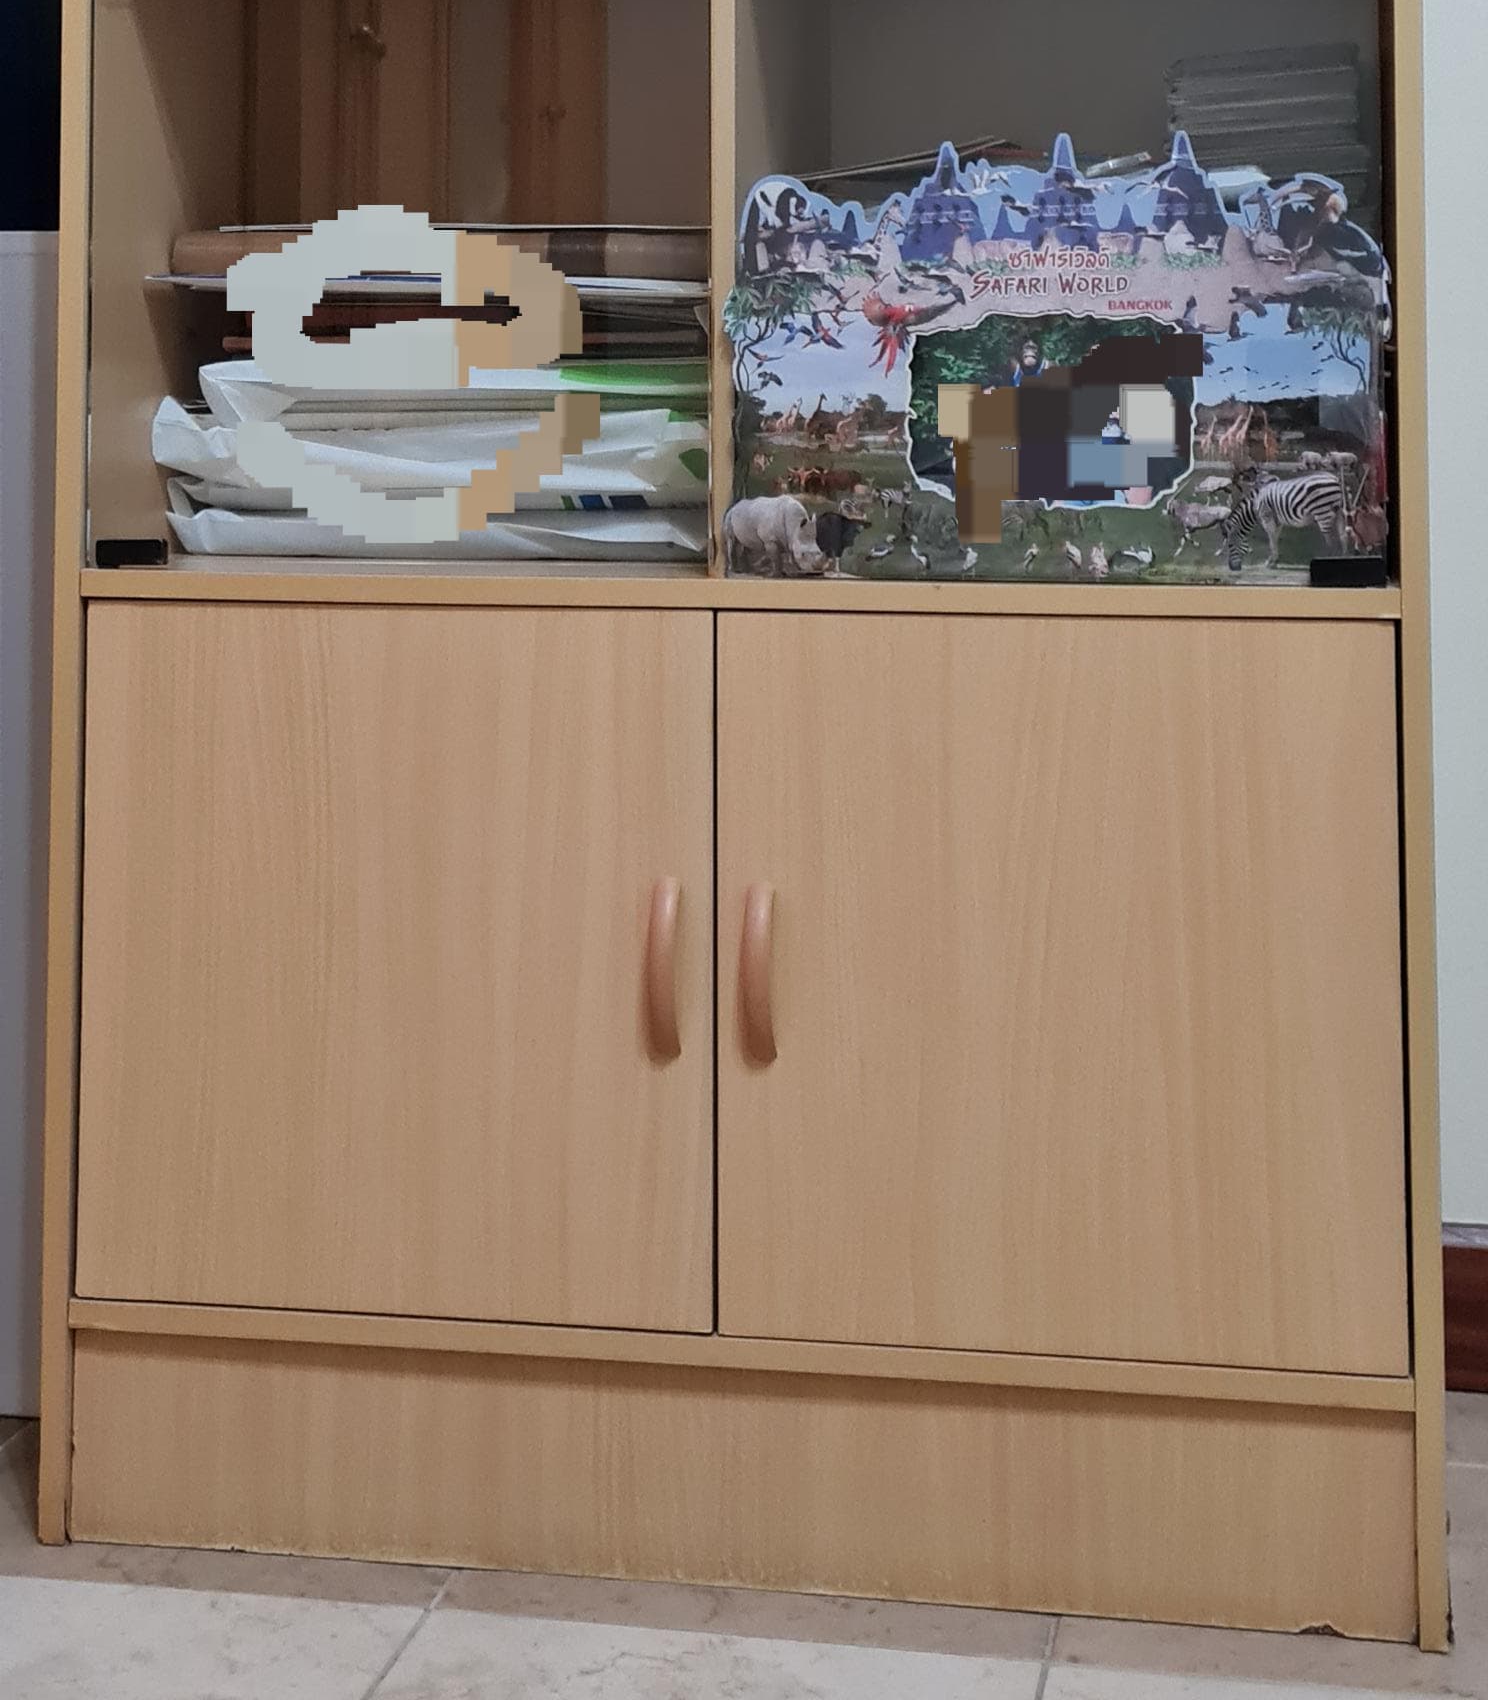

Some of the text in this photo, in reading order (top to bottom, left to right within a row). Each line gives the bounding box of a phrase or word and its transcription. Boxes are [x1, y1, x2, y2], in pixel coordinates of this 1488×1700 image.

[969, 270, 1128, 299] SAFARI WORLD
[1107, 300, 1173, 311] BANGKOK
